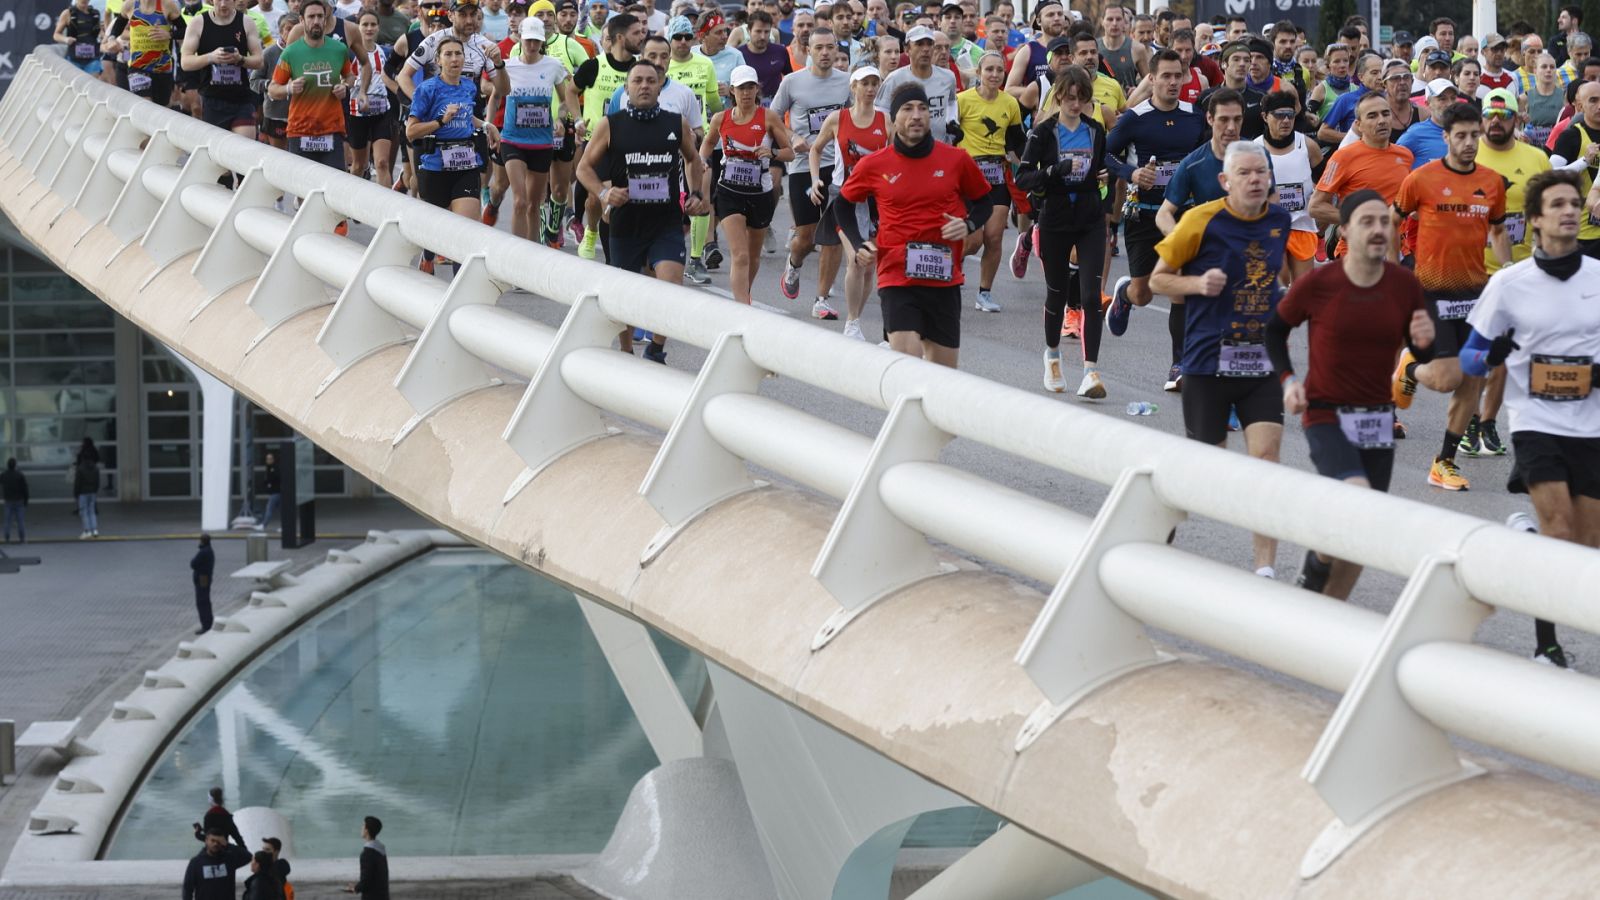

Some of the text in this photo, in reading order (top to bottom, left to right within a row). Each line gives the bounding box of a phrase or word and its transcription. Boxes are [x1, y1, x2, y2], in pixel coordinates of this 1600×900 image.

[625, 152, 673, 166] Villalpardo
[731, 172, 754, 181] HELEN
[1437, 203, 1489, 214] NEVER STOP
[1229, 360, 1265, 371] Claude
